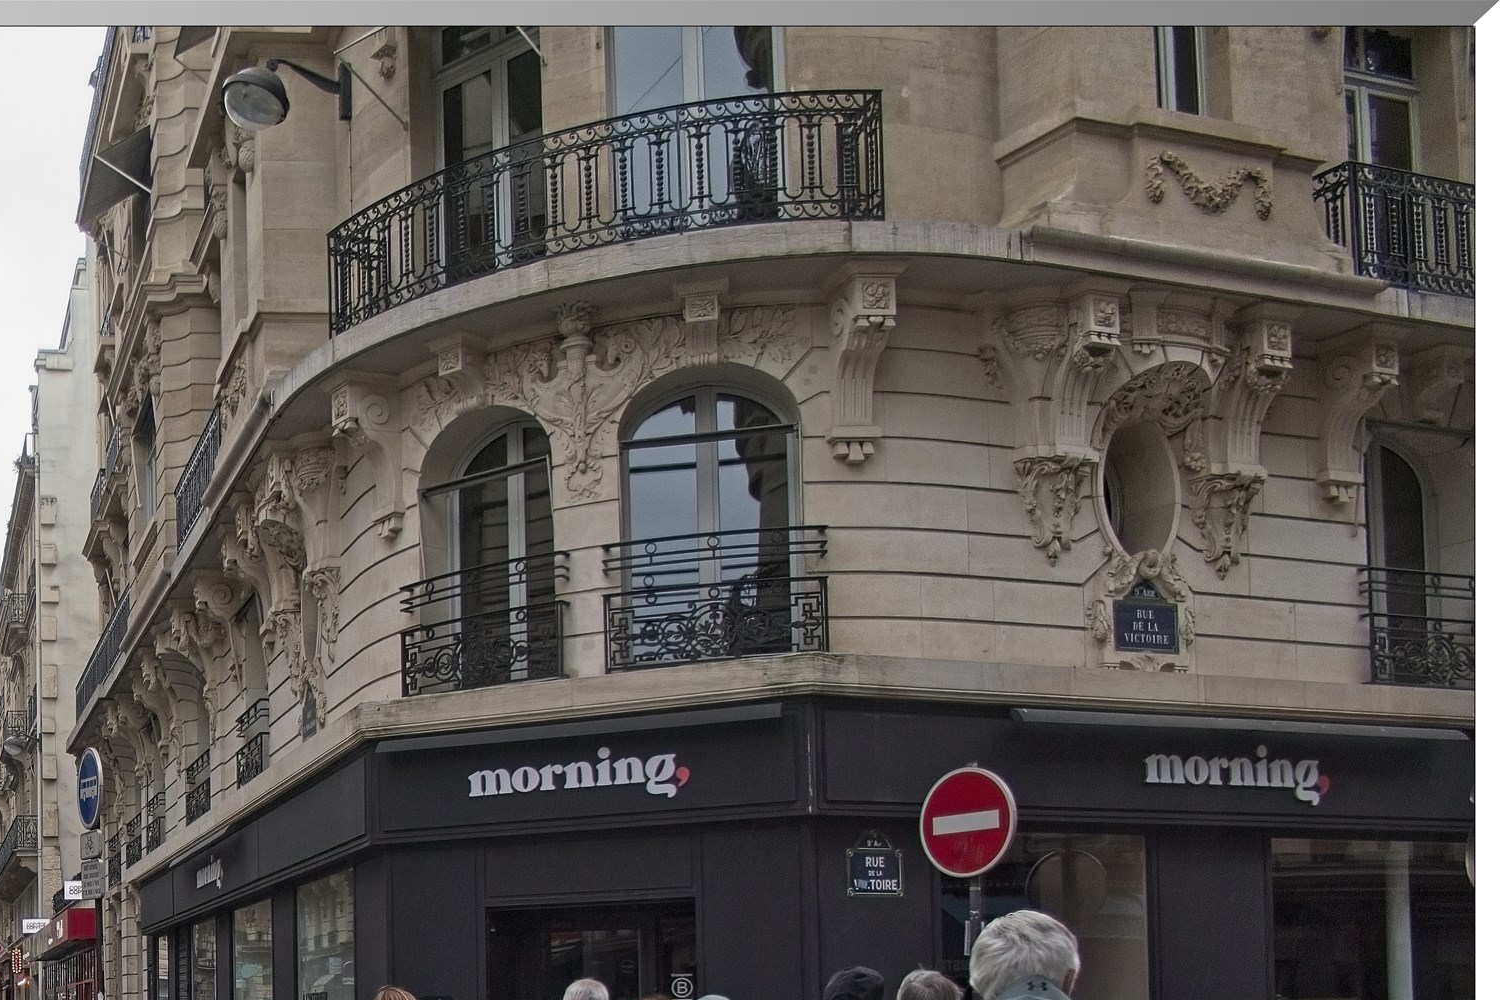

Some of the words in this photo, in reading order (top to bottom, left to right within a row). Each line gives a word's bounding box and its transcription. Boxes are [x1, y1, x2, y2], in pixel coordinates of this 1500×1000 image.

[1136, 609, 1155, 620] RUE
[1132, 621, 1144, 631] DE
[1147, 622, 1159, 632] LA
[1124, 632, 1169, 645] VICTOIRE
[865, 856, 885, 868] RUE
[853, 878, 898, 891] VTOIRE
